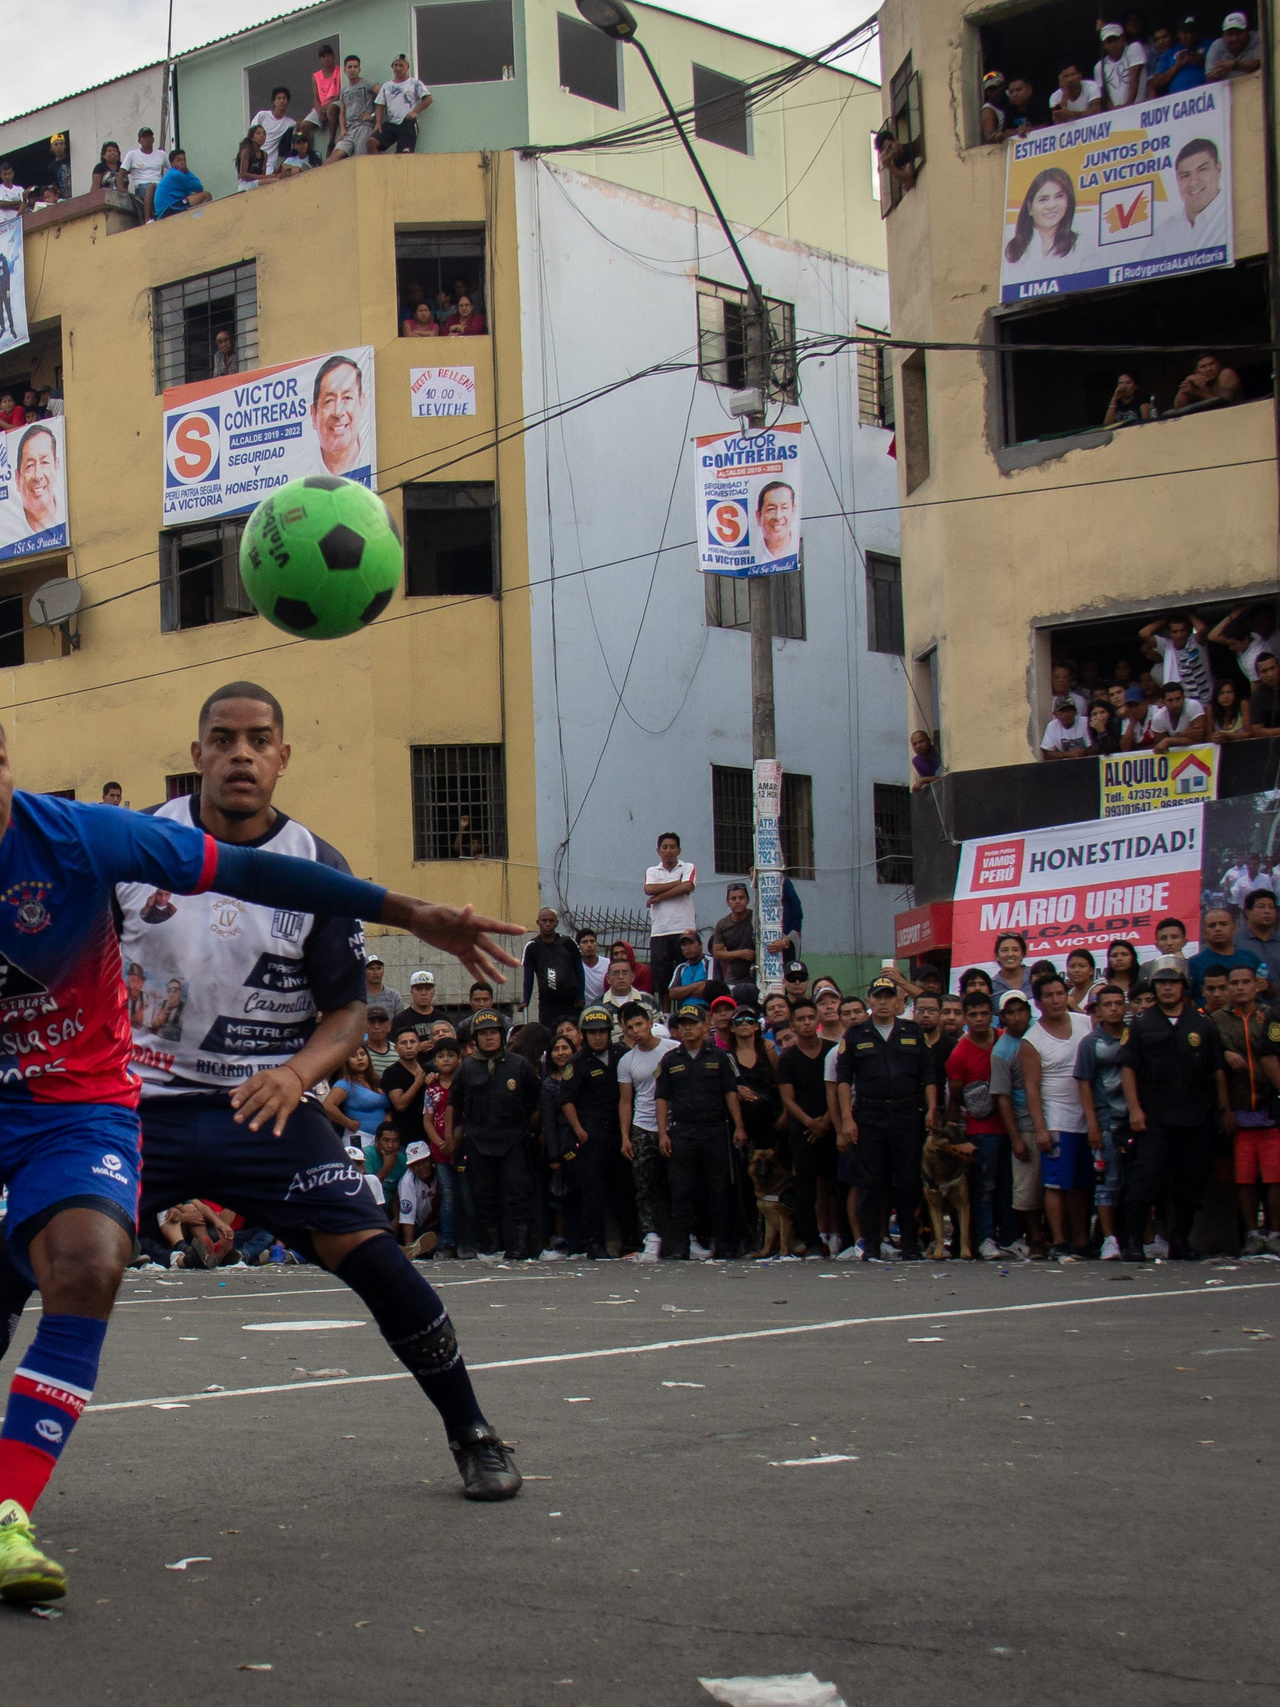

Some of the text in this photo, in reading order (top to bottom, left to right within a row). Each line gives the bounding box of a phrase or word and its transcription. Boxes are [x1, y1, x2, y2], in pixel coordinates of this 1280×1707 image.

[1141, 91, 1215, 129] RUDY GARCÍA
[1015, 121, 1111, 160] ESTHER CAPUNAY
[1083, 135, 1170, 169] JUNTOS POR
[1080, 155, 1172, 189] LA VICTORIA
[1020, 280, 1059, 298] LIMA
[234, 378, 298, 408] VICTOR
[224, 398, 307, 431] CONTRERAS
[419, 403, 469, 416] CEVICHE
[231, 433, 263, 446] ALCALDE
[264, 430, 280, 441] 2019
[285, 426, 301, 437] 2022
[724, 434, 776, 452] VICTOR
[174, 416, 211, 478] S
[228, 447, 285, 467] SEGURIDAD
[702, 445, 798, 468] CONTRERAS
[253, 465, 260, 476] Y
[166, 483, 222, 500] PERÚ PATRIA SEGURA
[225, 475, 288, 495] HONESTIDAD
[164, 494, 223, 513] LA VICTORIA
[715, 505, 741, 543] S
[702, 554, 756, 565] LA VICTORIA
[1104, 756, 1168, 788] ALQUILO
[758, 782, 778, 790] AMAR
[1127, 787, 1169, 800] 4735724
[758, 819, 778, 828] ATRA
[1030, 828, 1195, 873] HONESTIDAD!
[982, 854, 1016, 868] VAMOS
[761, 876, 781, 886] ATRA
[979, 865, 1015, 883] PERÚ
[980, 882, 1169, 932] MARIO URIBE
[220, 910, 237, 927] LV
[1021, 915, 1151, 940] LCALDE
[1029, 931, 1140, 951] LA VICTORIA
[46, 1008, 85, 1046] SAC
[475, 1014, 498, 1024] POLICIA
[585, 1014, 607, 1022] POLICIA
[224, 1038, 305, 1050] MAZZINI
[196, 1058, 253, 1077] RICARDO
[91, 1165, 128, 1185] WALON
[284, 1164, 364, 1201] Avanty
